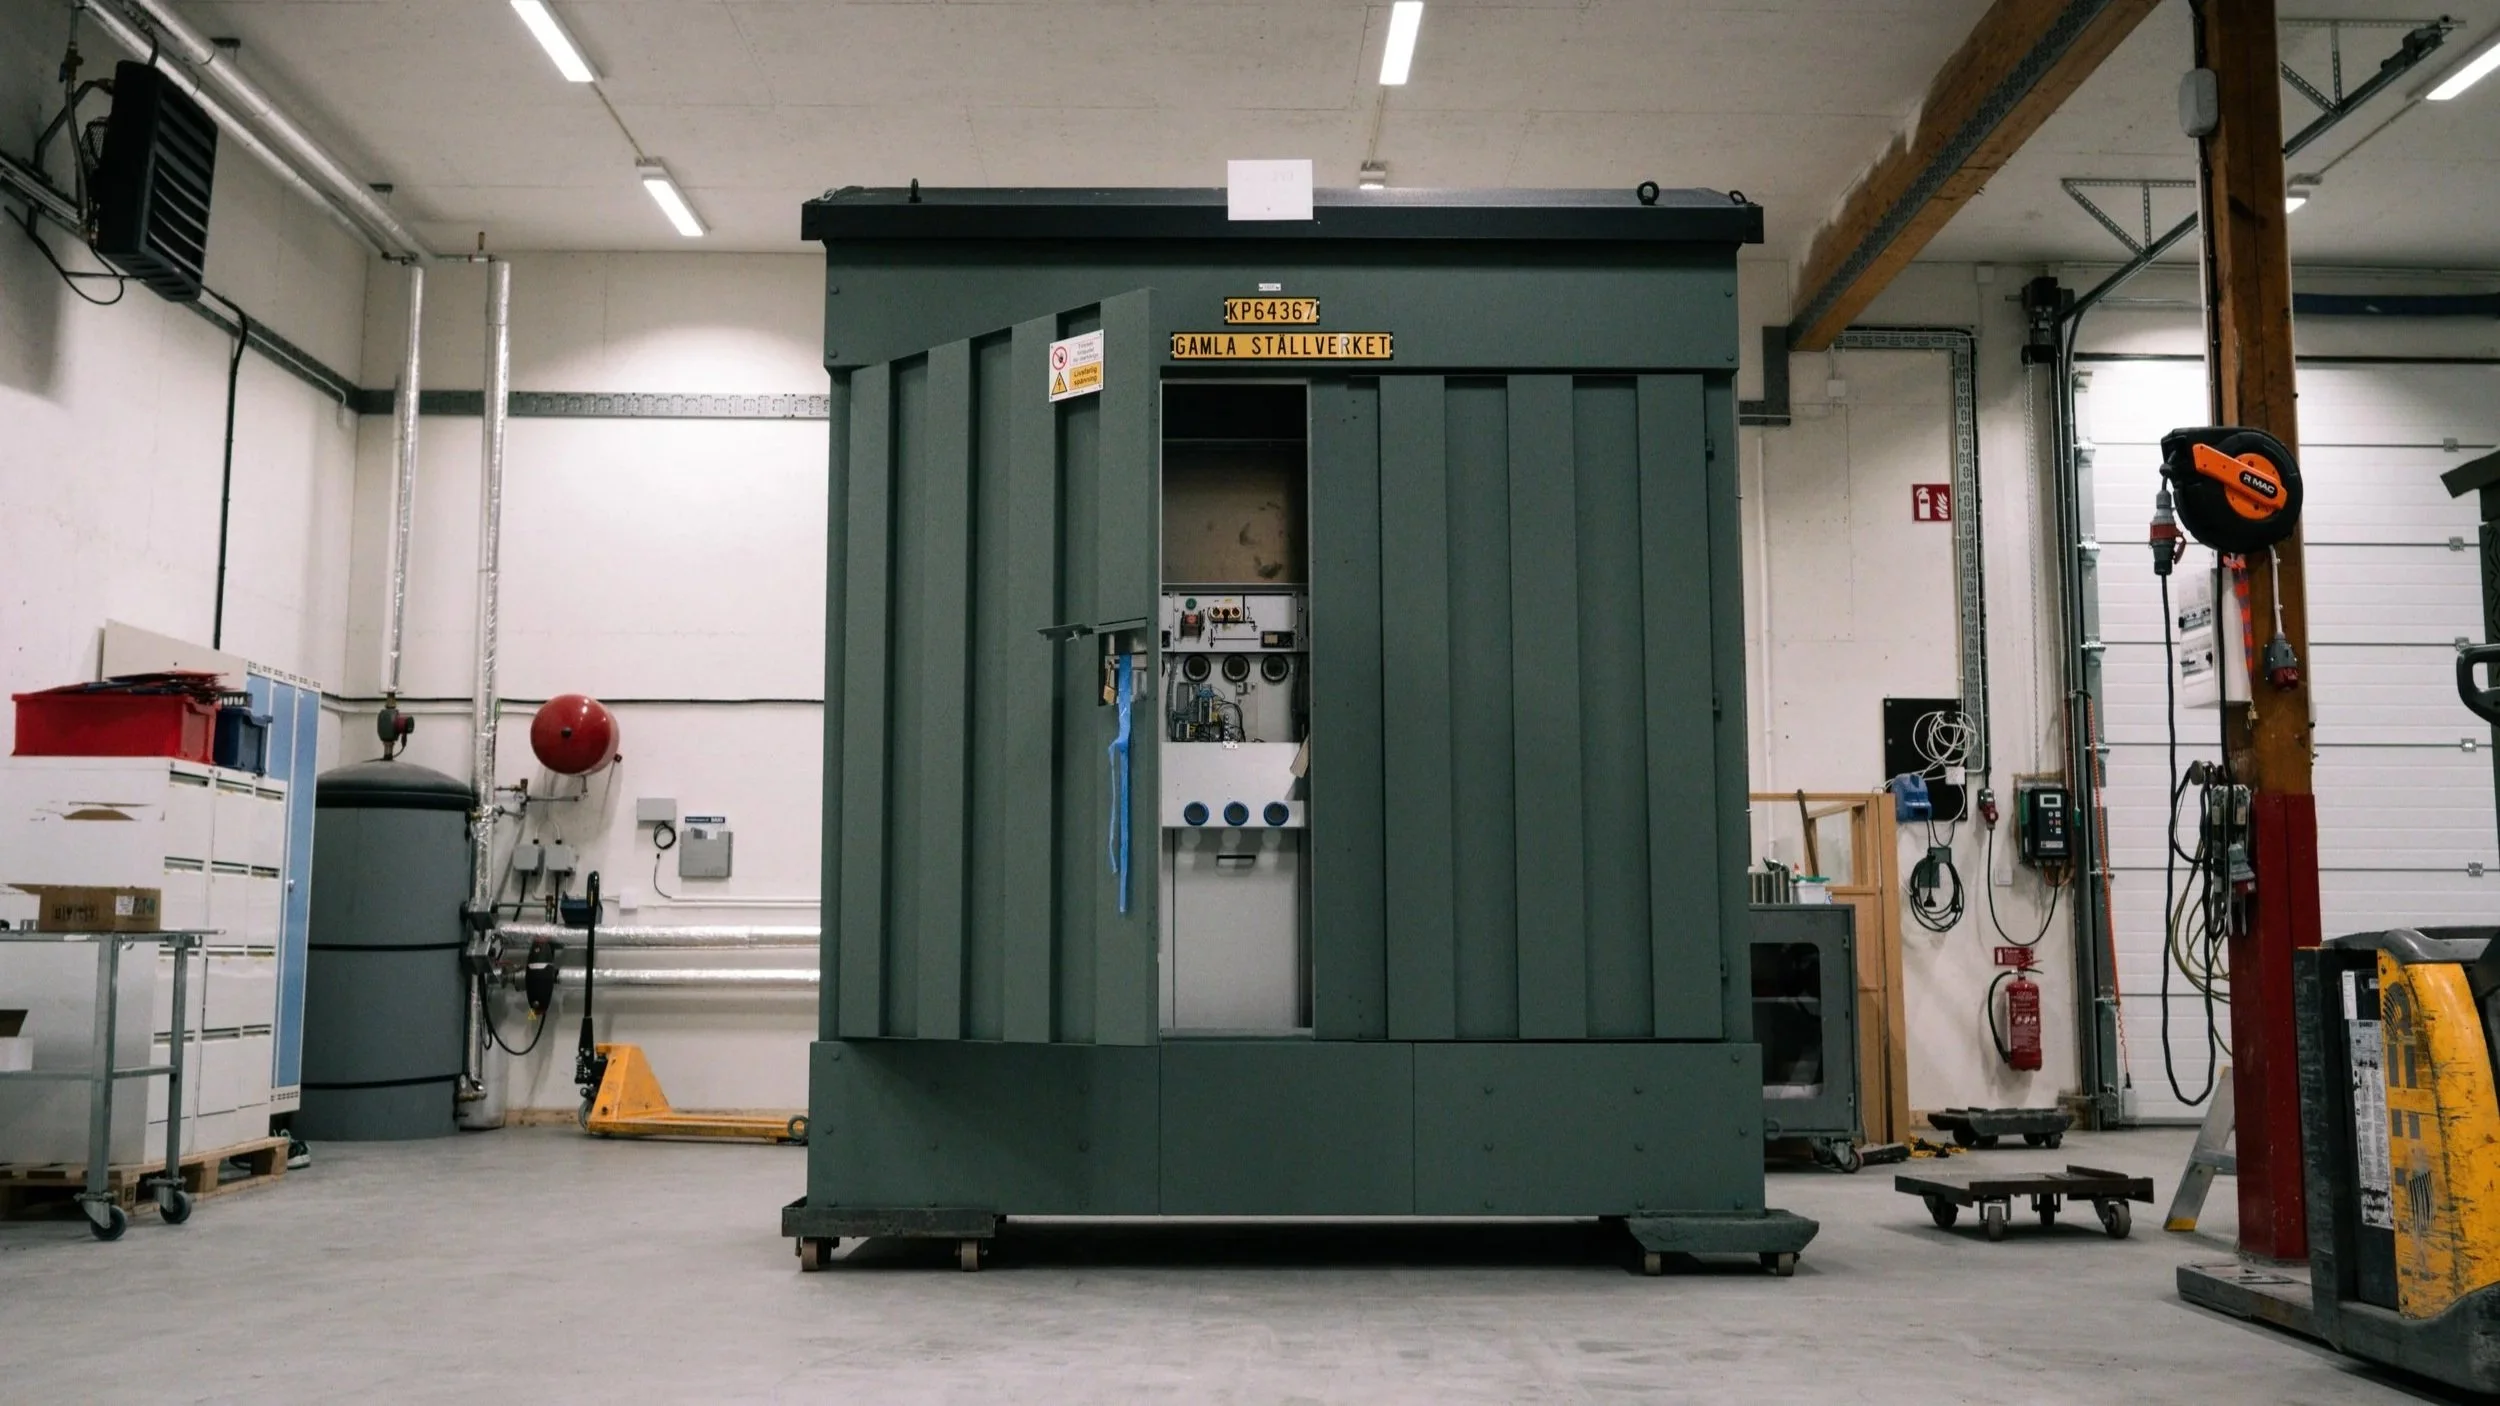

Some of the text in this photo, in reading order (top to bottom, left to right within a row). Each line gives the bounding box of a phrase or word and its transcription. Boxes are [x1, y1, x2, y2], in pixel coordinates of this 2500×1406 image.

[1229, 301, 1315, 320] KP64367
[1175, 333, 1388, 355] GAMLA STÄLLVERKET
[2252, 478, 2275, 494] MAC
